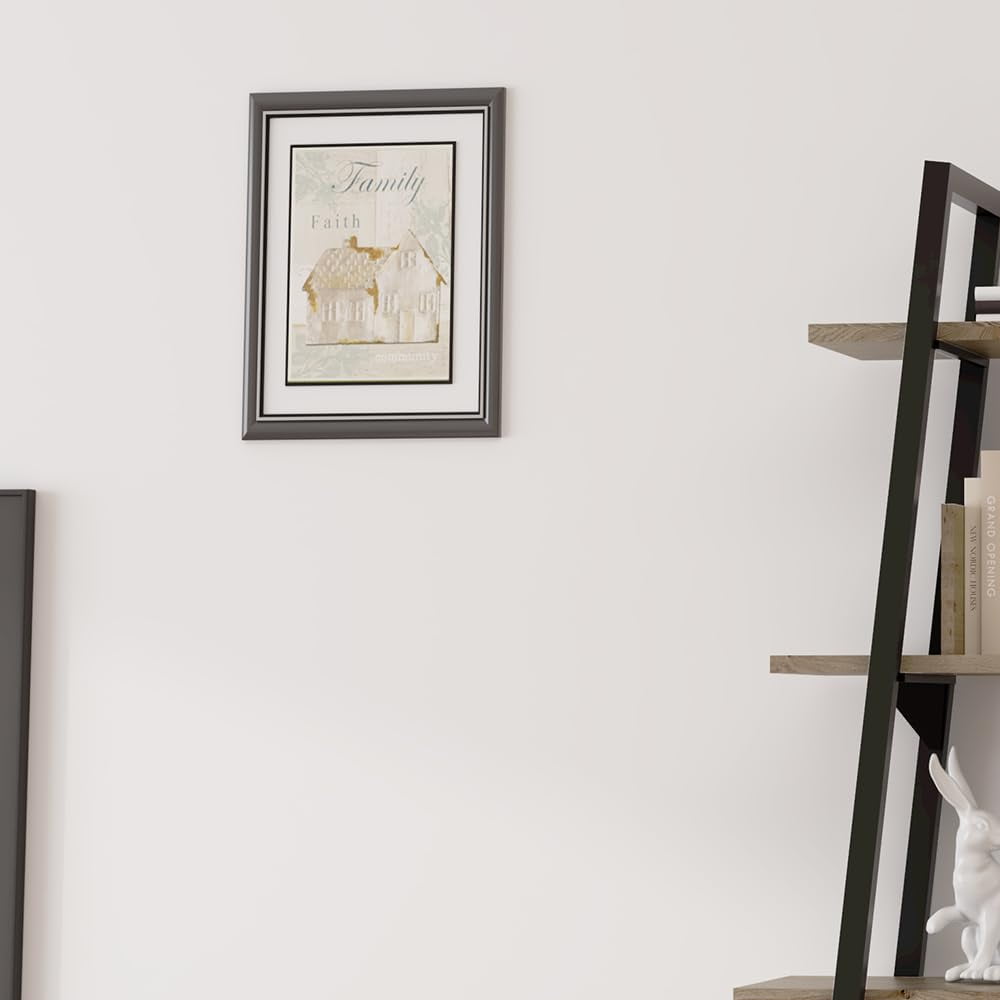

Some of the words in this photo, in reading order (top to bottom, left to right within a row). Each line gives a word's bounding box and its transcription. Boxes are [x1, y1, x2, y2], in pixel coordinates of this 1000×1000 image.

[331, 160, 424, 206] Family
[311, 214, 360, 229] Faith
[986, 495, 996, 537] GRAND
[986, 543, 996, 598] OPENING
